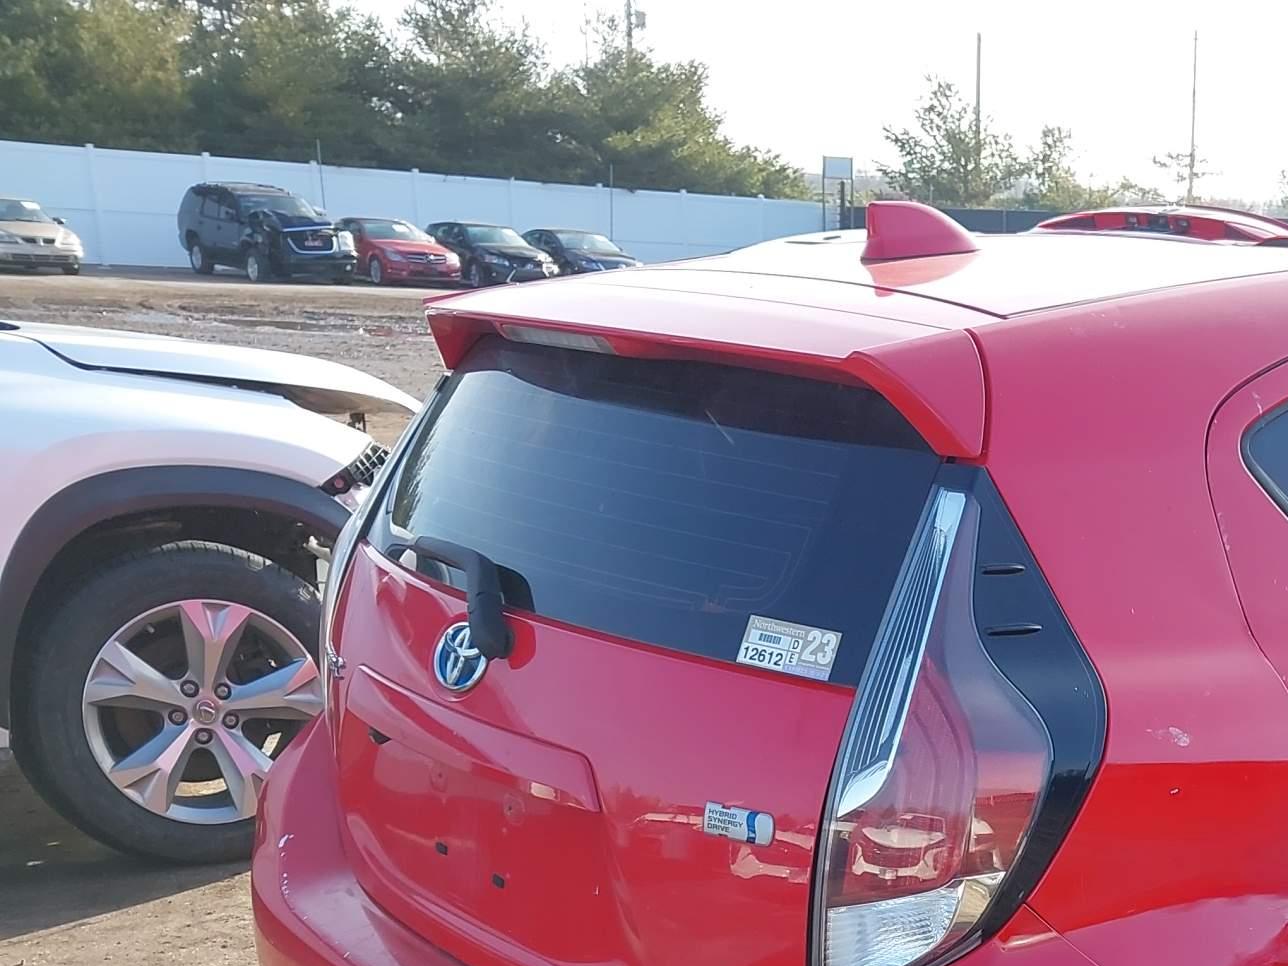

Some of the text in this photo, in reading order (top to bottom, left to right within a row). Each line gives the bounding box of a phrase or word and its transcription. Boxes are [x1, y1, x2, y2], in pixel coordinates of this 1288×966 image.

[752, 619, 806, 638] Northwestern
[791, 639, 800, 650] D
[801, 630, 837, 666] 23
[743, 646, 784, 667] 12612
[708, 808, 738, 820] HYBRID
[707, 816, 744, 828] SYNERGY
[707, 823, 731, 833] DRIVE
